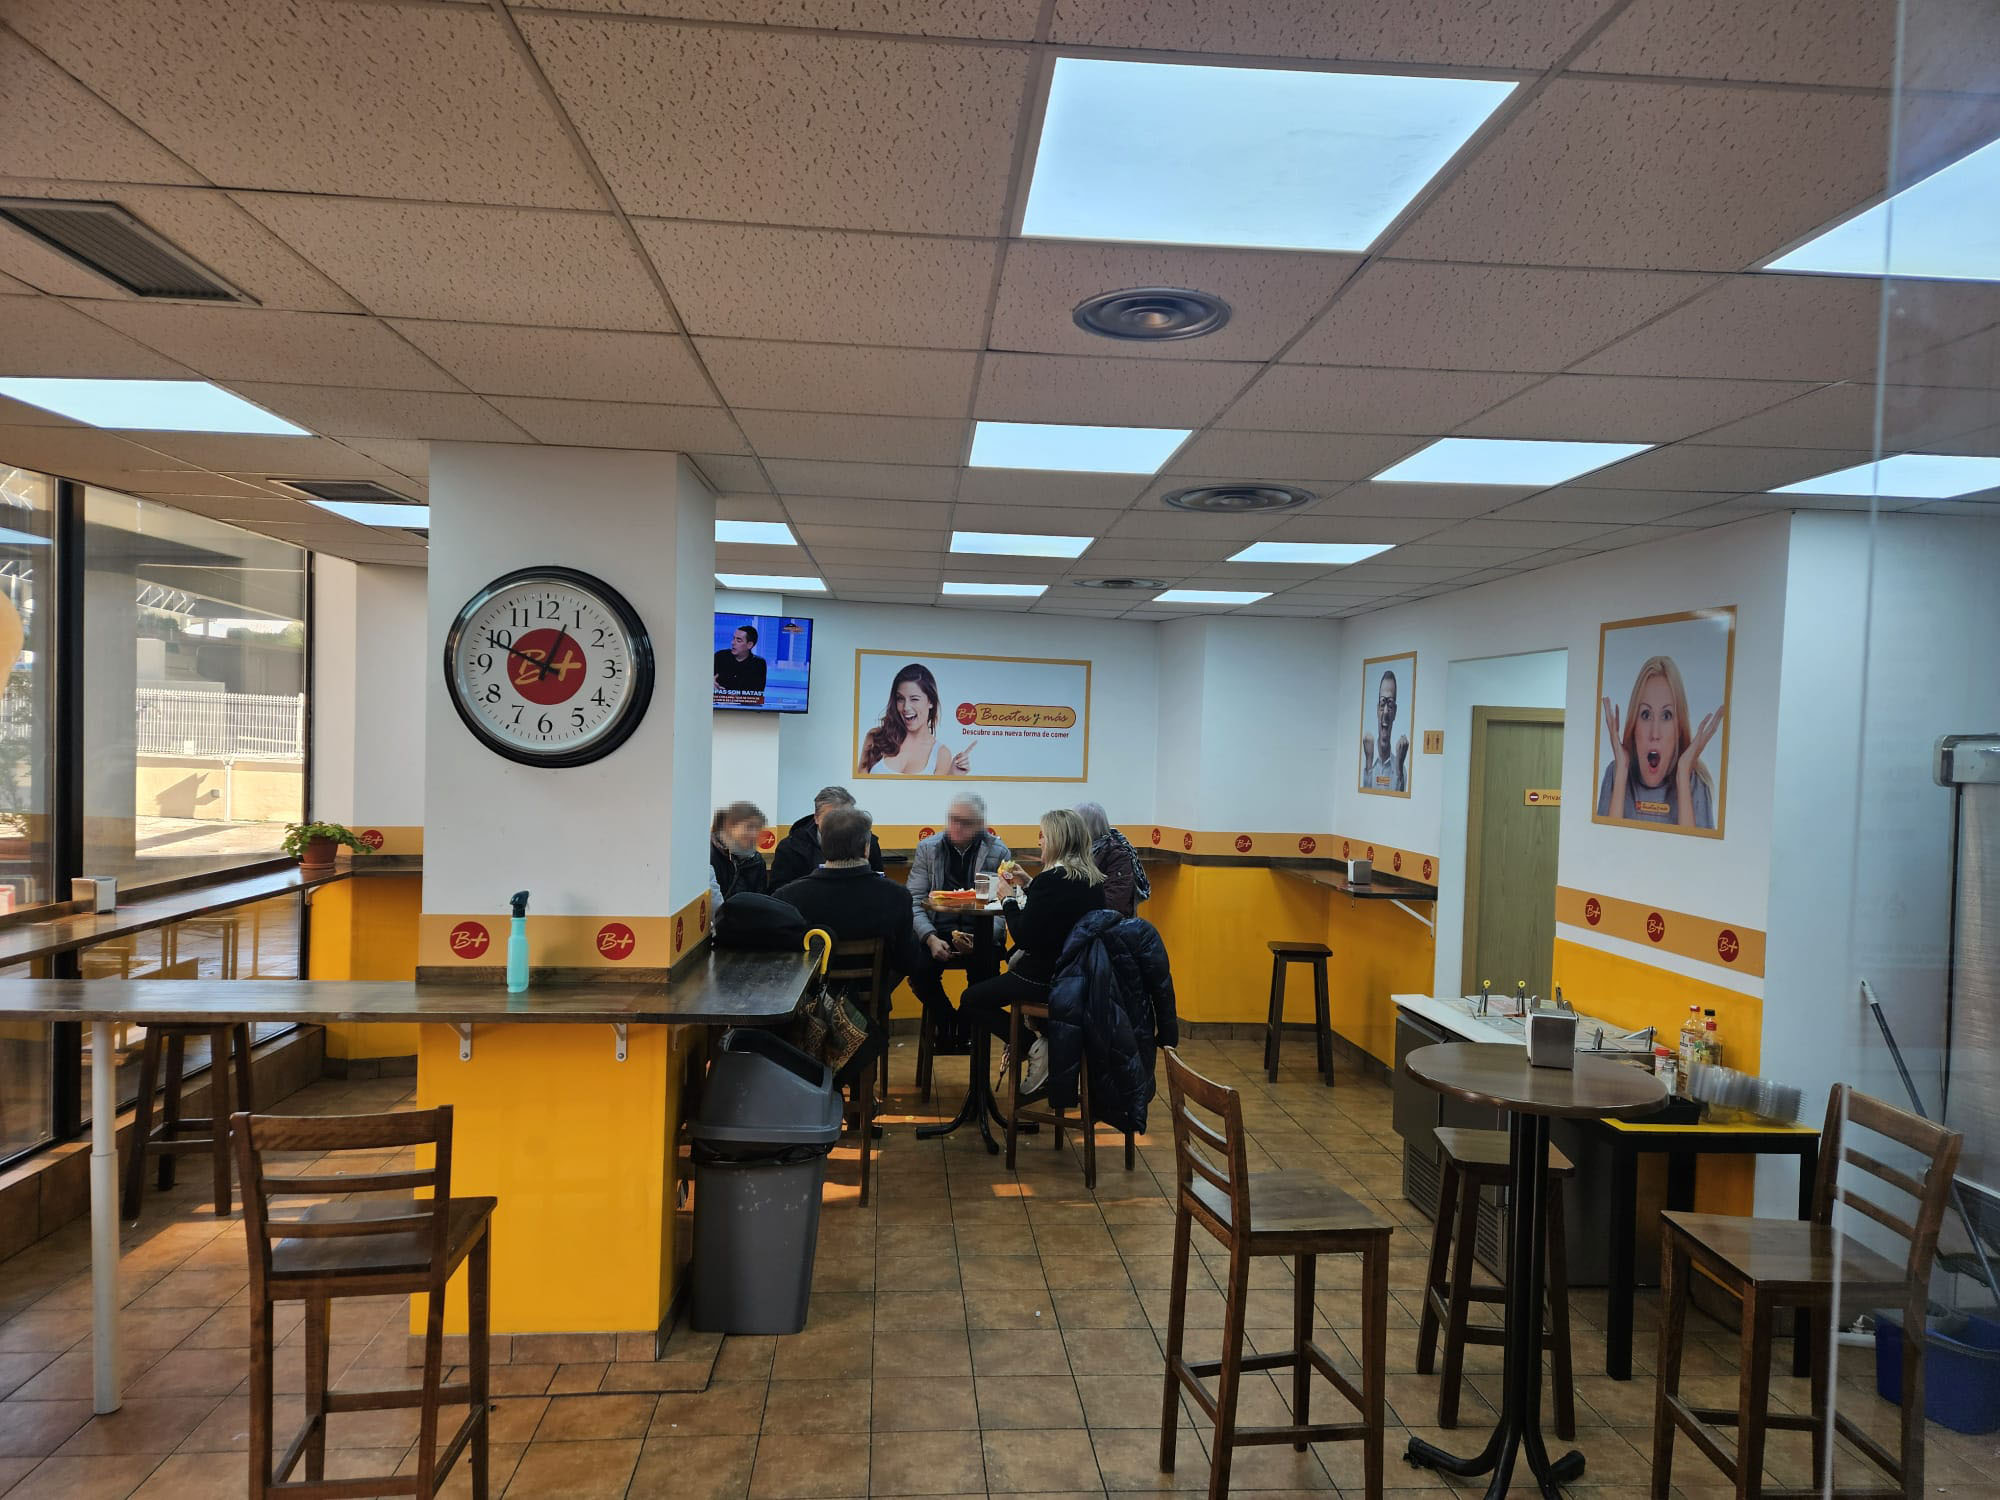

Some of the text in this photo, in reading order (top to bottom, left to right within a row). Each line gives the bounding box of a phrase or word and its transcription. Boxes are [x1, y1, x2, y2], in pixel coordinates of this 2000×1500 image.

[511, 608, 529, 627] 11
[536, 600, 560, 620] 12
[574, 610, 582, 629] 1
[488, 629, 512, 649] 10
[591, 629, 605, 648] 2
[477, 653, 493, 675] 9
[602, 659, 616, 679] 3
[486, 683, 502, 704] 8
[590, 687, 606, 706] 4
[511, 704, 525, 724] 7
[537, 712, 553, 734] 6
[571, 707, 585, 727] 5
[980, 707, 1032, 722] Bocatas
[1032, 711, 1041, 725] y
[1043, 712, 1069, 722] más
[962, 728, 991, 736] Descubre
[1023, 730, 1041, 738] forma
[1051, 731, 1070, 739] comer
[1585, 904, 1601, 918] B+
[1648, 919, 1664, 934] B+
[451, 931, 488, 950] B+
[599, 932, 633, 951] B+
[1718, 937, 1738, 953] B+
